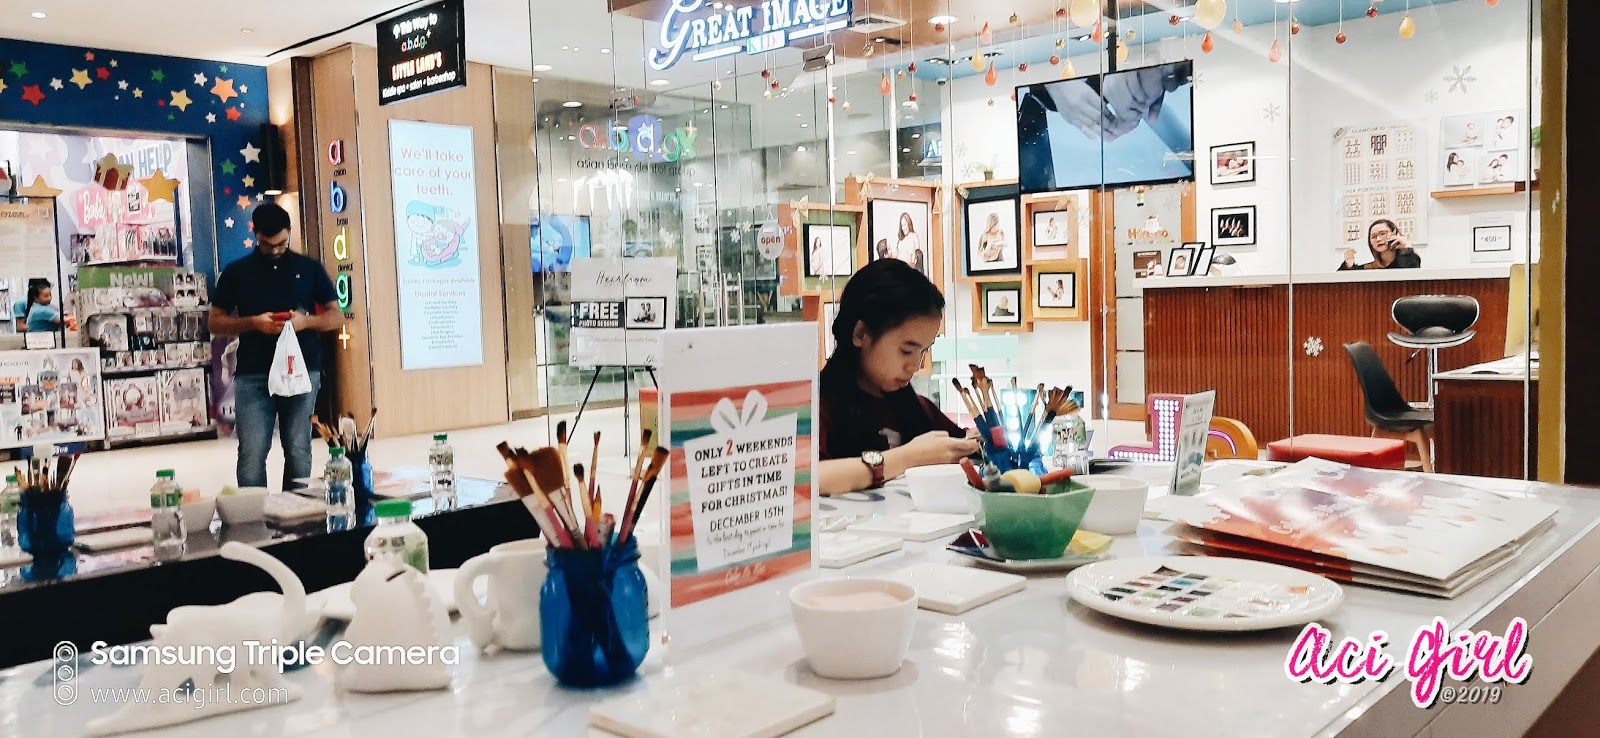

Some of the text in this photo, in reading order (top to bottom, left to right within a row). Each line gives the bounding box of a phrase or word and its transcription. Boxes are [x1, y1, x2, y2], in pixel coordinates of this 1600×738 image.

[400, 12, 438, 35] This Way to
[649, 0, 848, 70] GREAT IMAGE
[137, 142, 172, 177] HELP
[401, 147, 464, 162] We'll take
[394, 166, 472, 181] care of your
[416, 182, 453, 196] teeth.
[761, 236, 781, 246] open
[580, 302, 619, 320] FREE
[694, 436, 793, 462] ONLY 2 WEEKENDS
[701, 453, 788, 478] LEFT TO CREATE
[707, 470, 782, 494] GIFTS IN TIME
[701, 485, 788, 514] FOR CHRISTMAS!
[710, 505, 784, 533] DECEMBER 15TH
